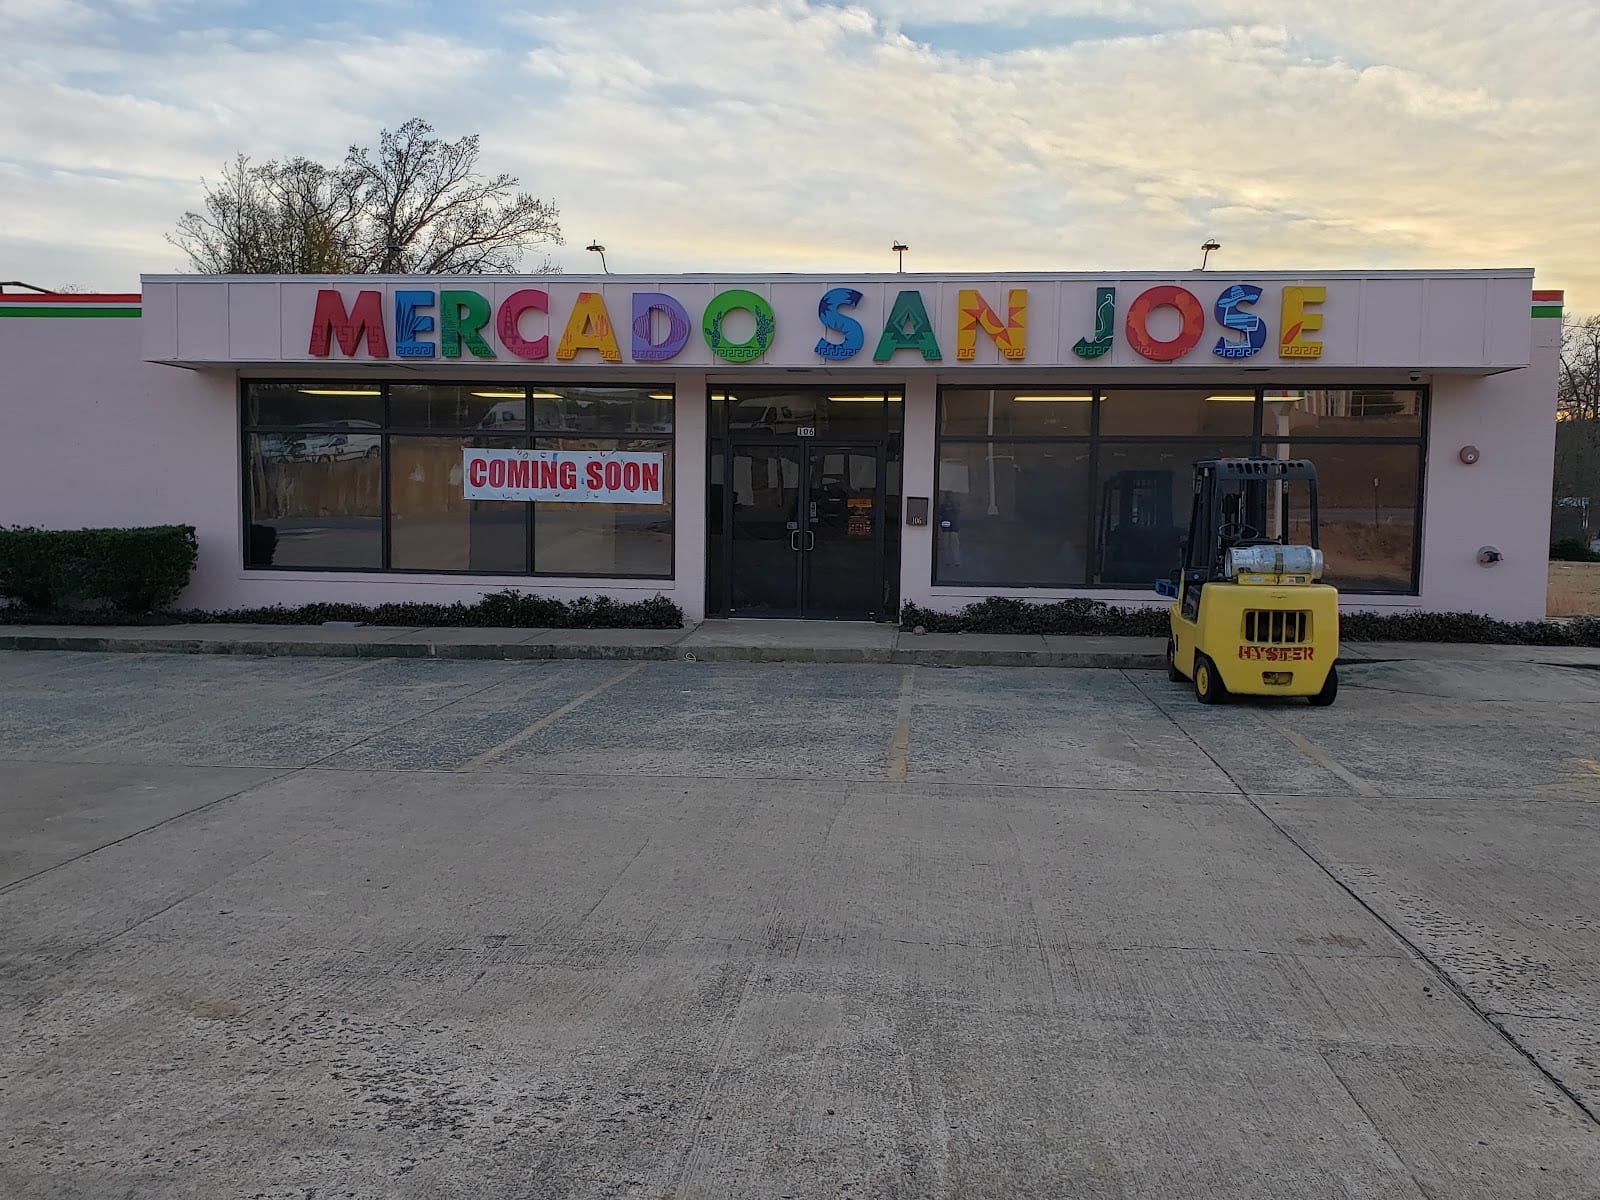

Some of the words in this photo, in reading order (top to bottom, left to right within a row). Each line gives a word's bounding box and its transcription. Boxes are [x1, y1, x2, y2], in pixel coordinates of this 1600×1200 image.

[309, 288, 775, 363] MERCADO
[814, 287, 1027, 361] SAN
[1071, 284, 1326, 361] JOSE
[798, 427, 814, 436] 106
[469, 458, 577, 490] COMING
[586, 461, 659, 491] SOON
[1239, 645, 1314, 661] HYSTER
